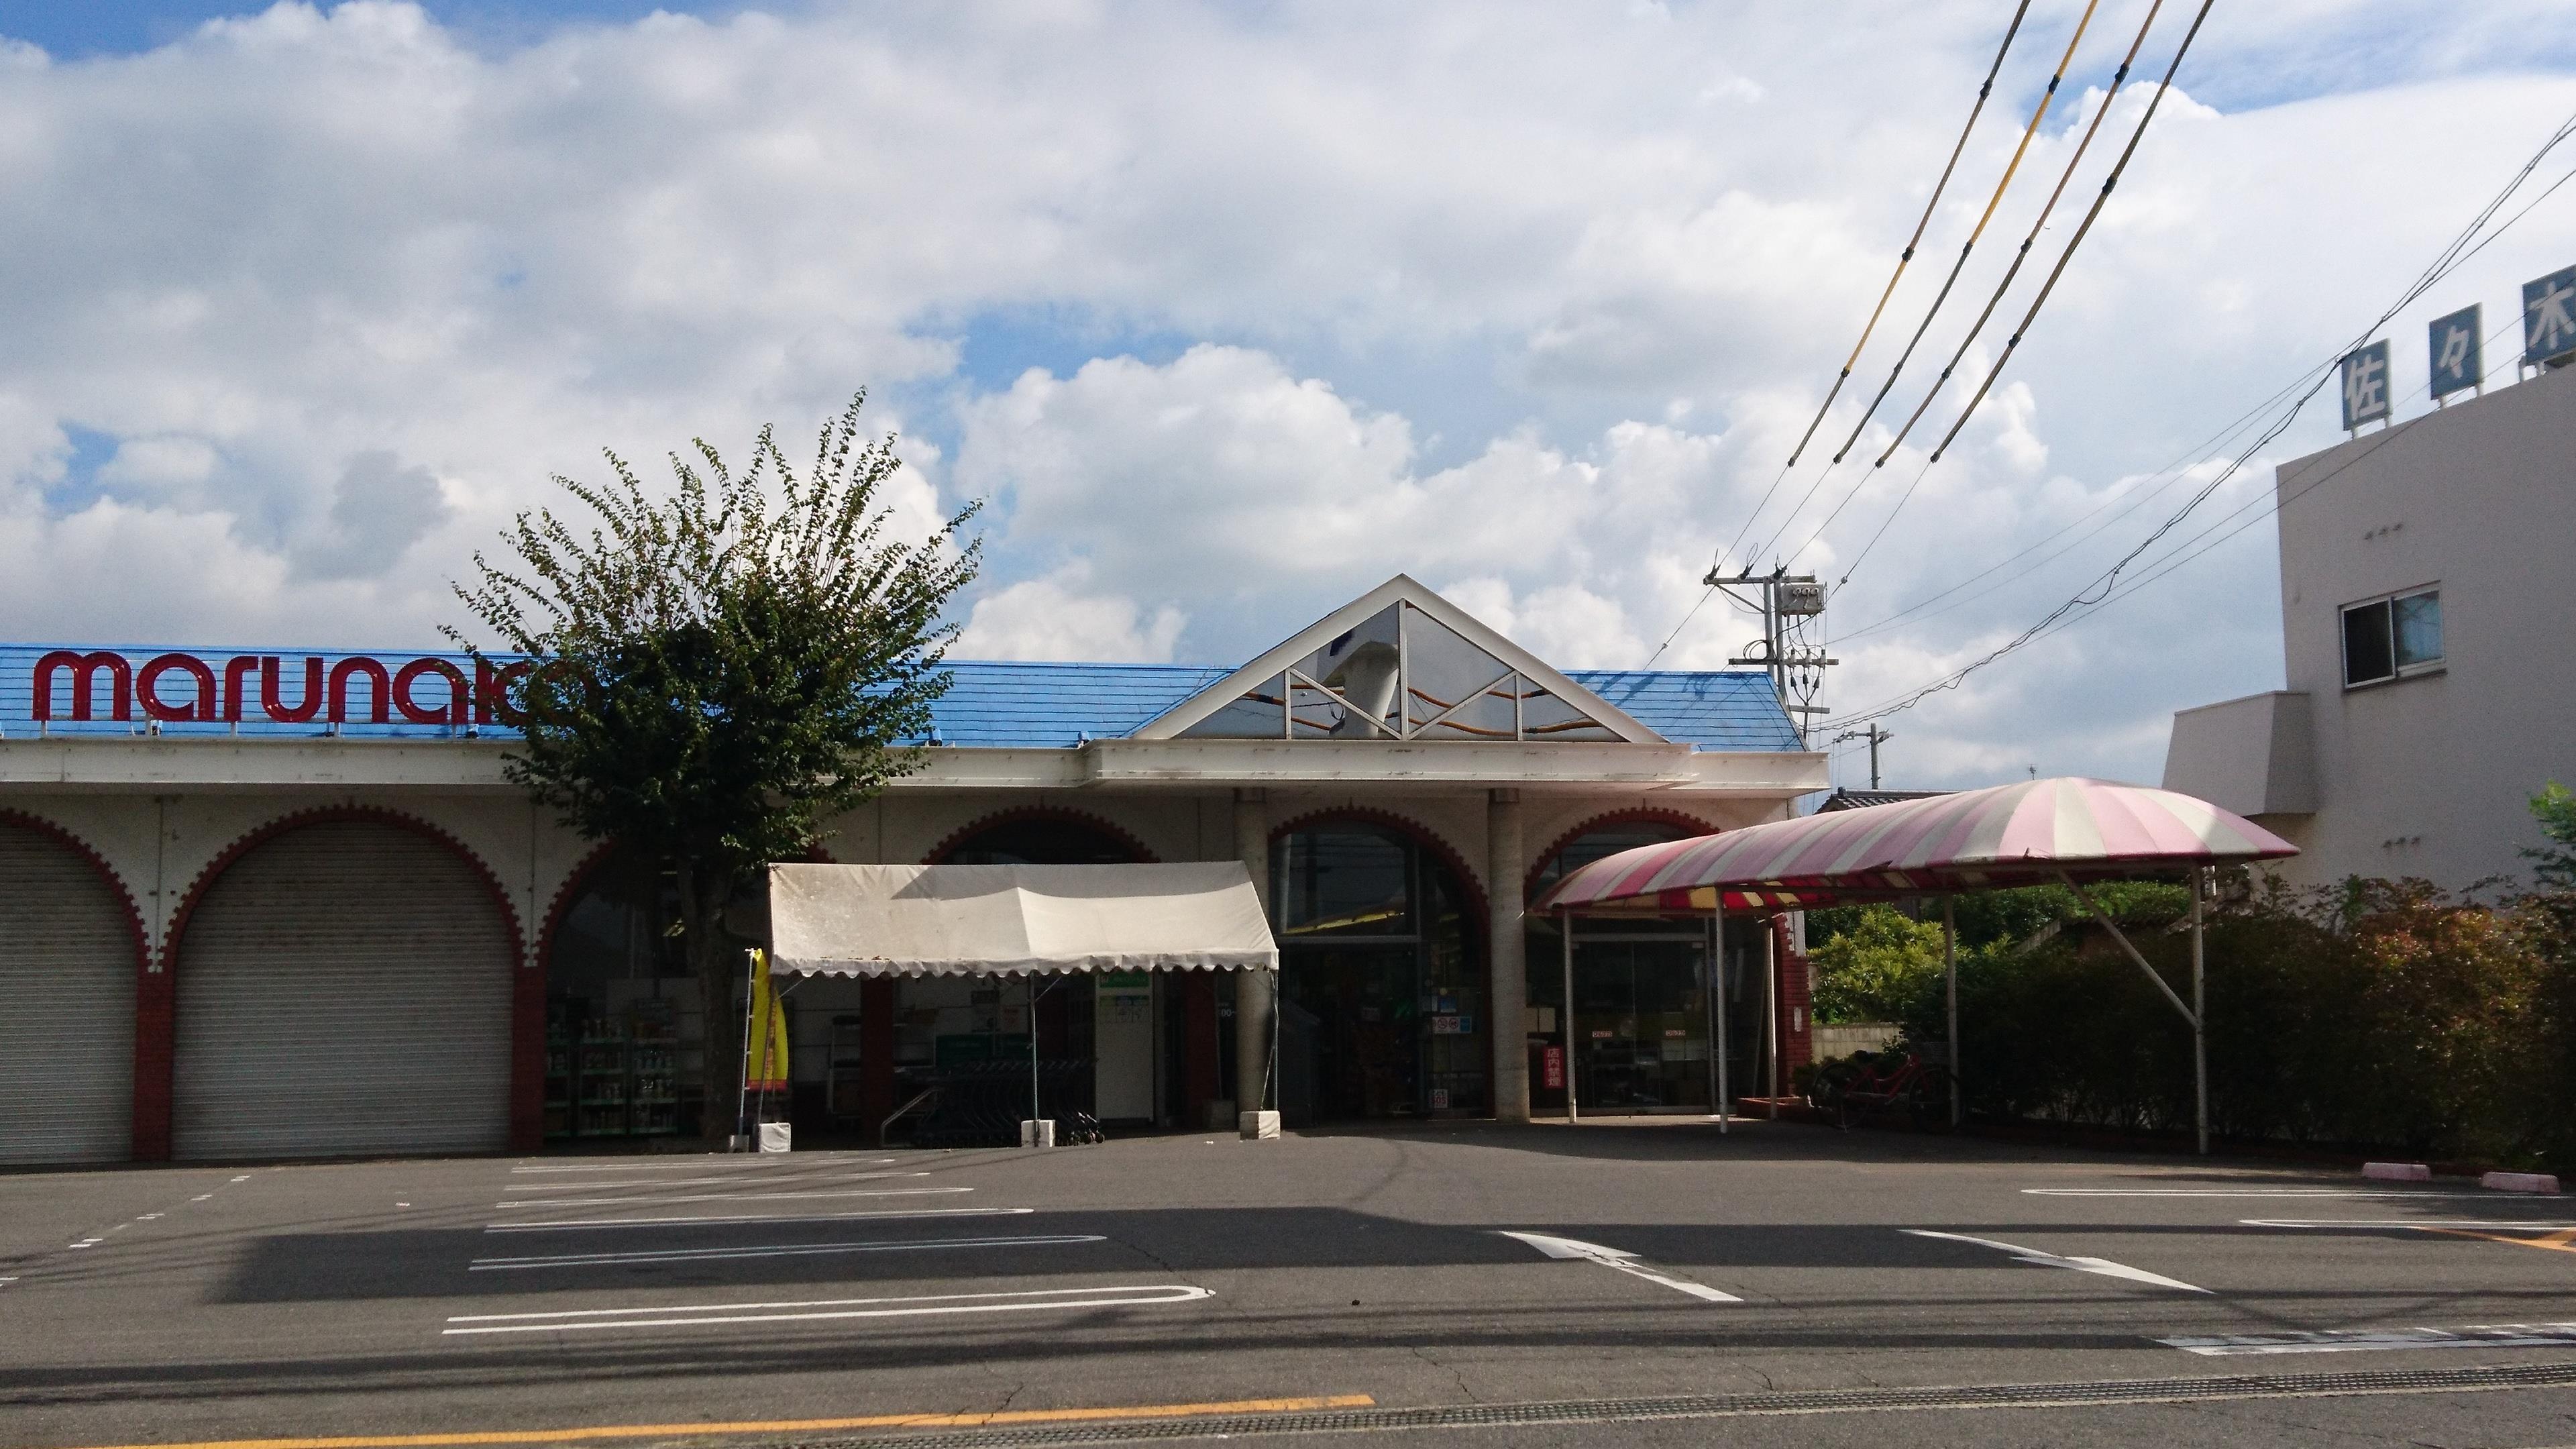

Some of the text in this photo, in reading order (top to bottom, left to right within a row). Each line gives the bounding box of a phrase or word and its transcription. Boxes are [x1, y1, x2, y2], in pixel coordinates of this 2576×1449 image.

[2345, 280, 2576, 423] 佐々木
[1547, 1048, 1562, 1087] 店内禁煙
